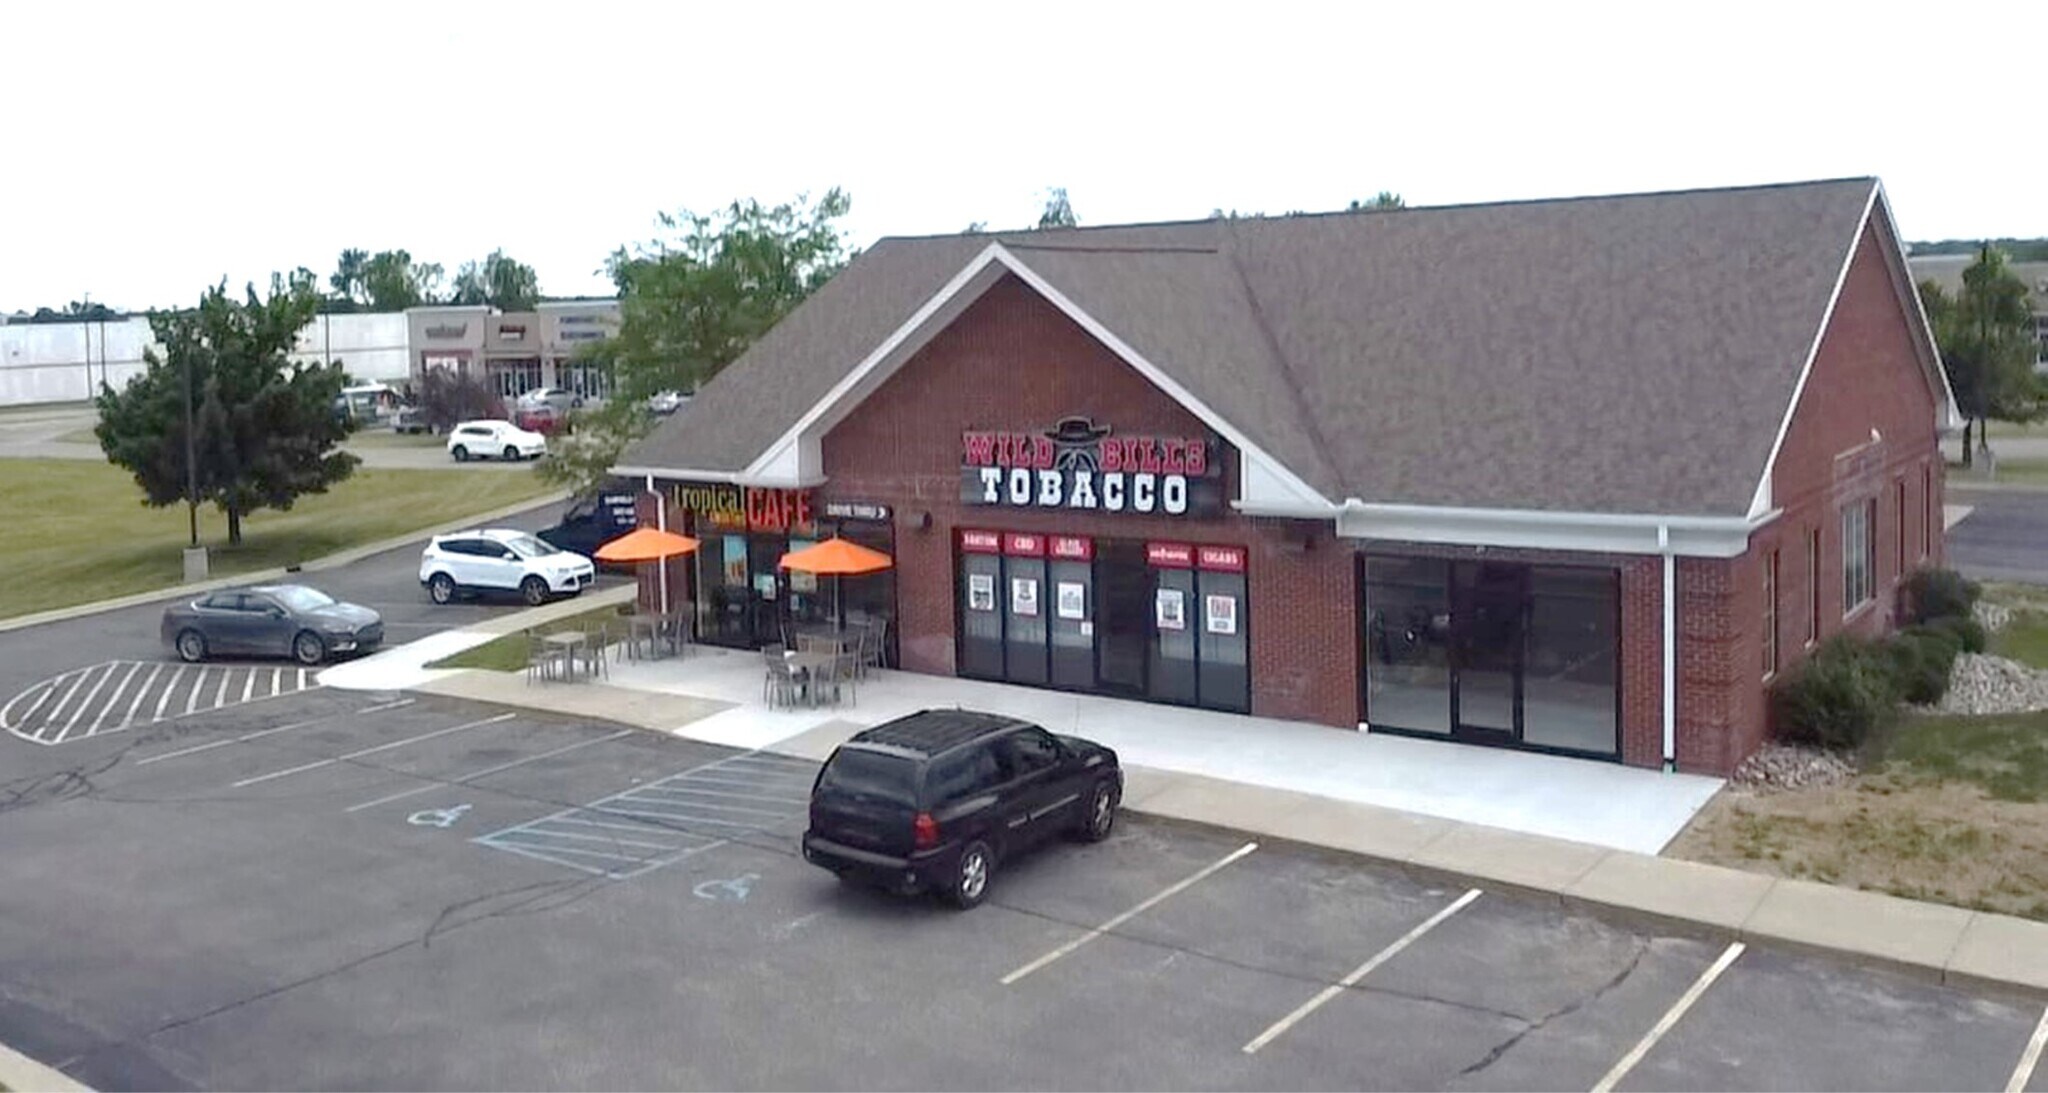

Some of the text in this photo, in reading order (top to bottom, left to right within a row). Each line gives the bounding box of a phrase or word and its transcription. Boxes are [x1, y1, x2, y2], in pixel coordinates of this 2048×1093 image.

[962, 430, 1206, 475] WILD BILLS
[746, 487, 811, 533] CAFE
[979, 467, 1188, 514] TOBACCO
[1013, 536, 1035, 551] CBD
